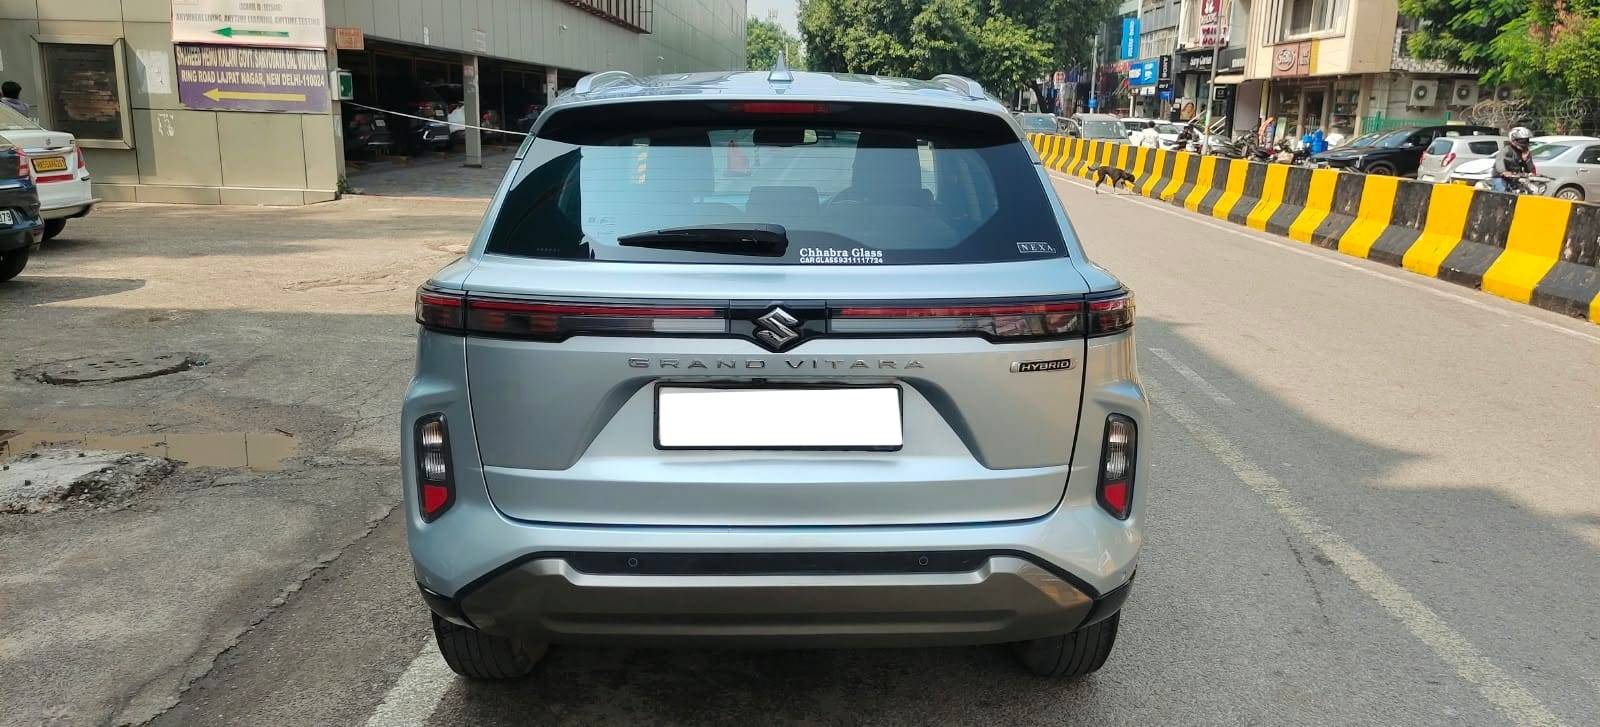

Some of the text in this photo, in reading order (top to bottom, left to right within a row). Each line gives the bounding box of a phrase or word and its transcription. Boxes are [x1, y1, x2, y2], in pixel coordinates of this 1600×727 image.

[176, 47, 201, 67] SHAHEED
[181, 71, 325, 87] RING ROAD LAJPAT NAGAR, NEW DELHI-110024
[799, 247, 883, 257] Chhabra Glass
[628, 358, 925, 369] GRAND VITARA
[1022, 360, 1070, 371] HYBRID
